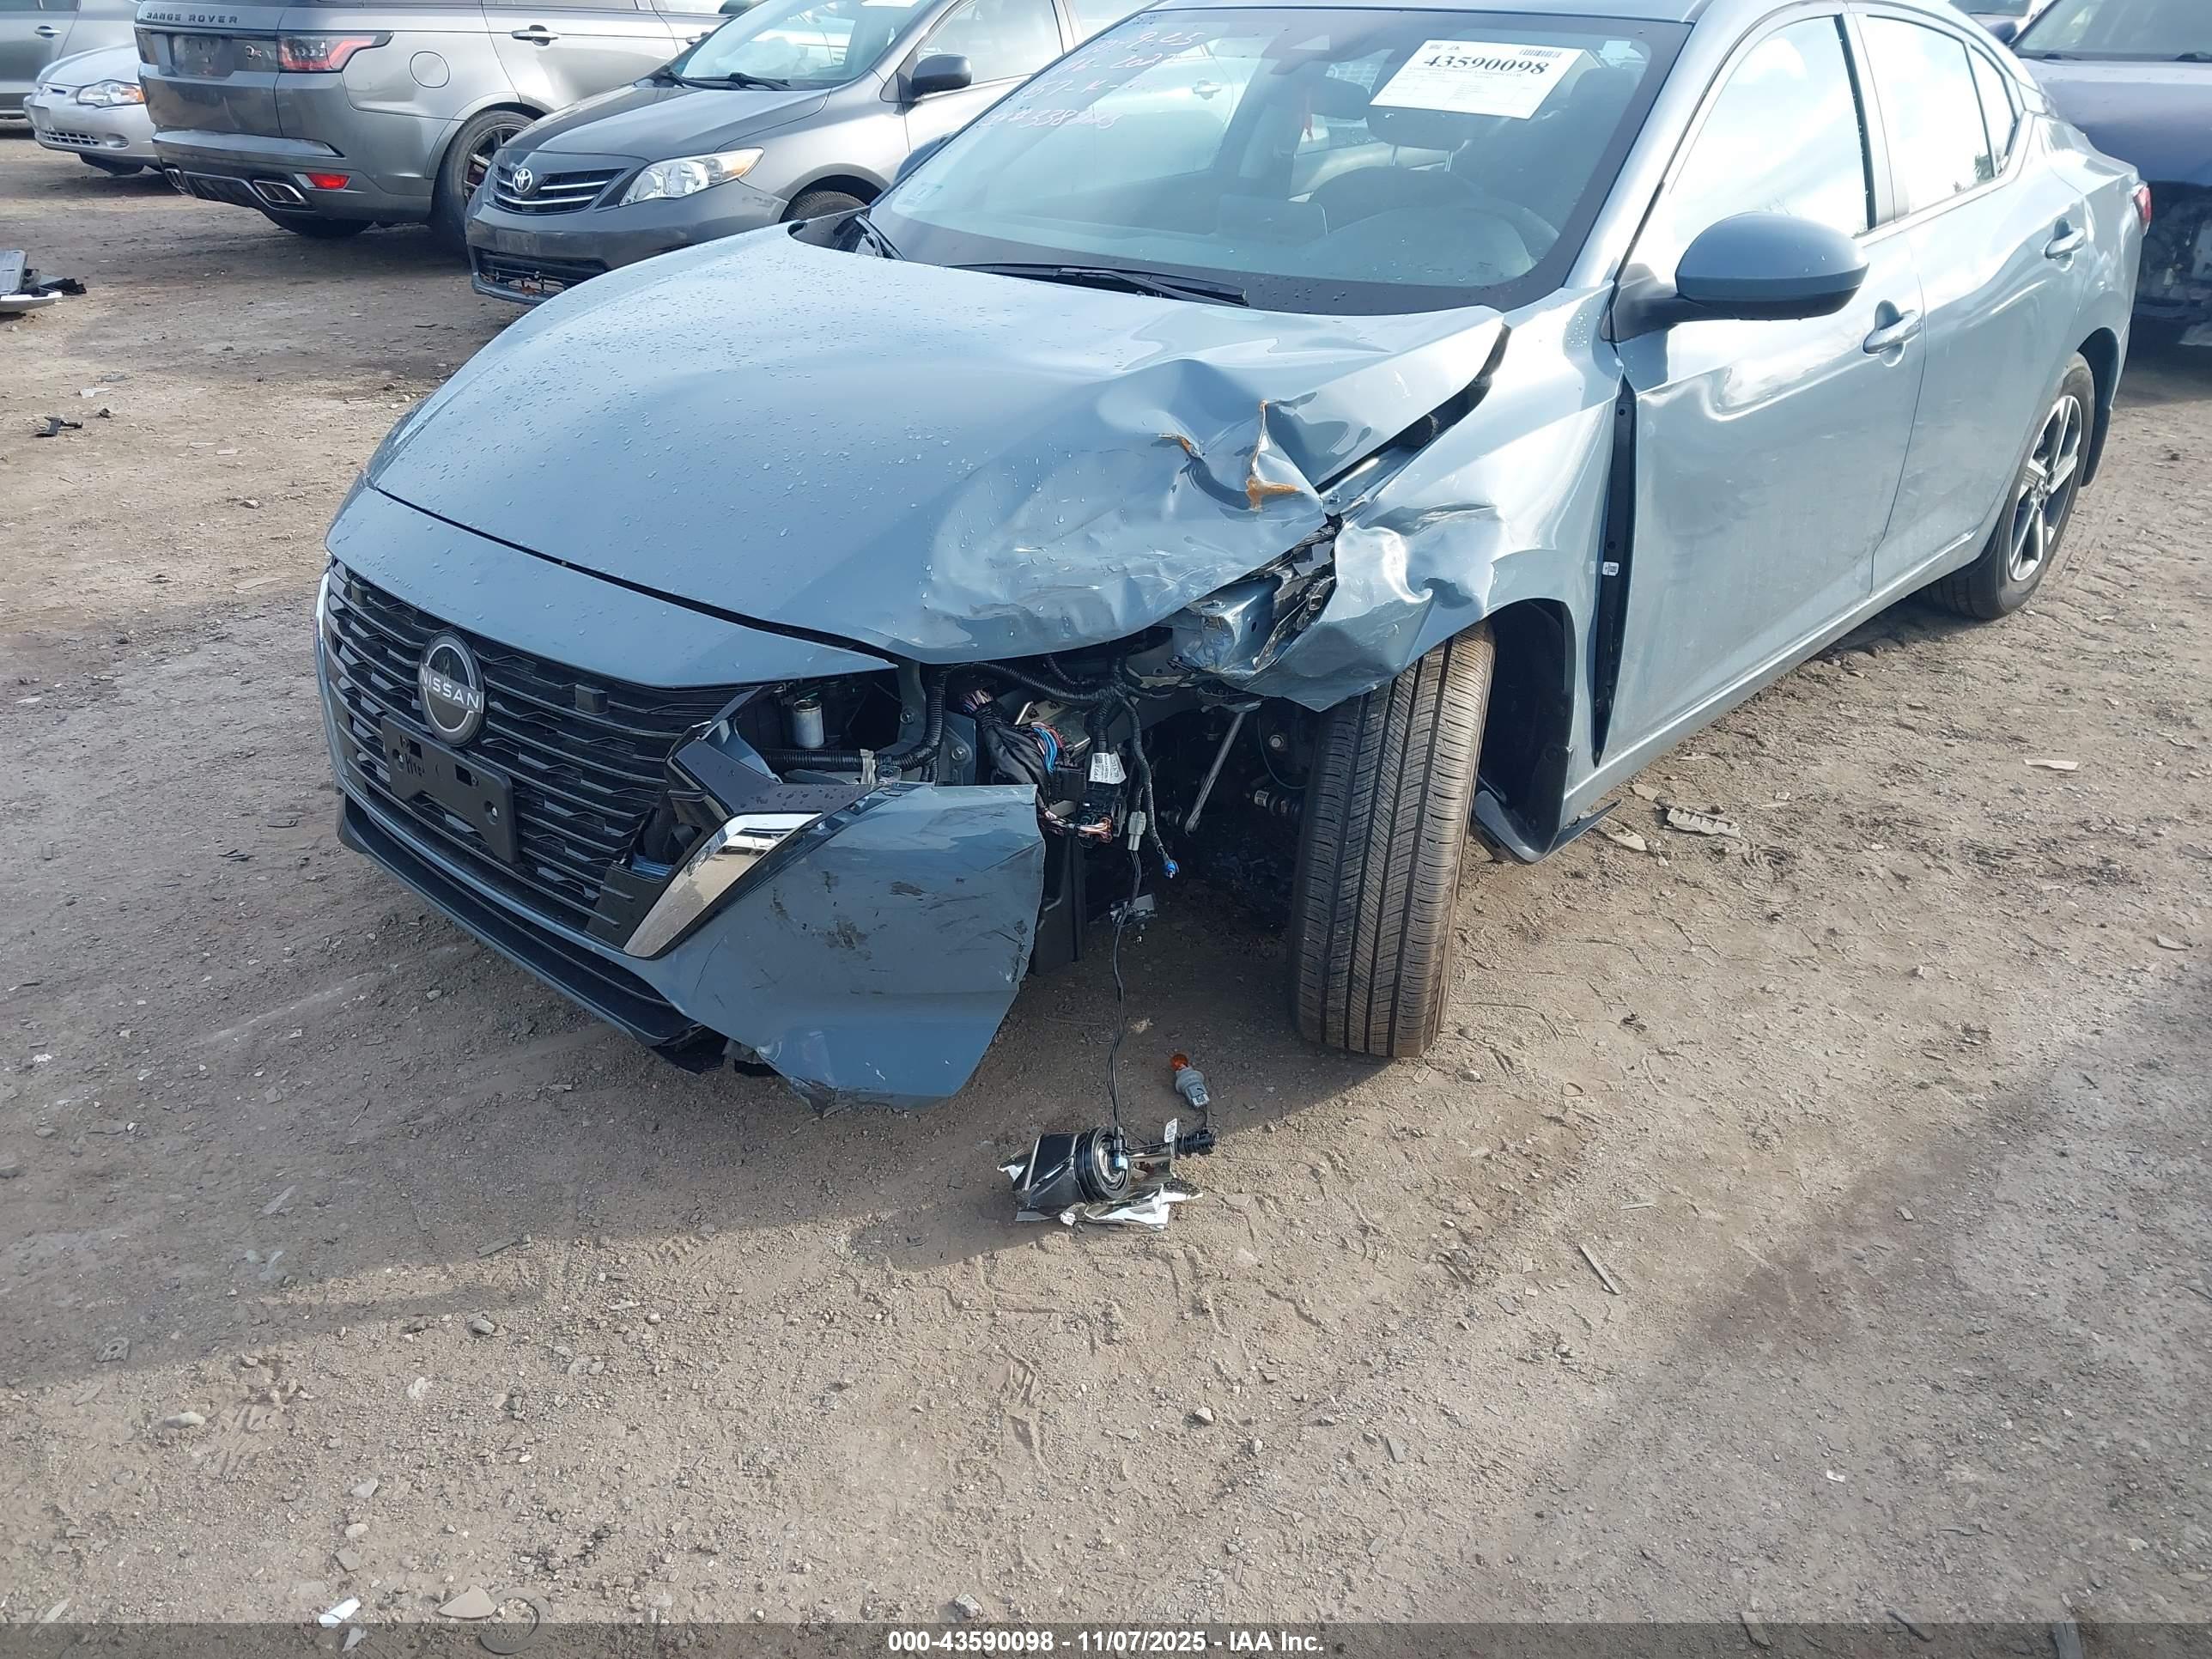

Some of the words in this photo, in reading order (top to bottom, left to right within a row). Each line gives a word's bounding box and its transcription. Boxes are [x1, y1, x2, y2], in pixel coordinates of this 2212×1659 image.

[146, 12, 181, 22] RANGE
[188, 14, 239, 24] ROVER
[1423, 54, 1550, 76] 43590098
[421, 668, 480, 709] NISSAN
